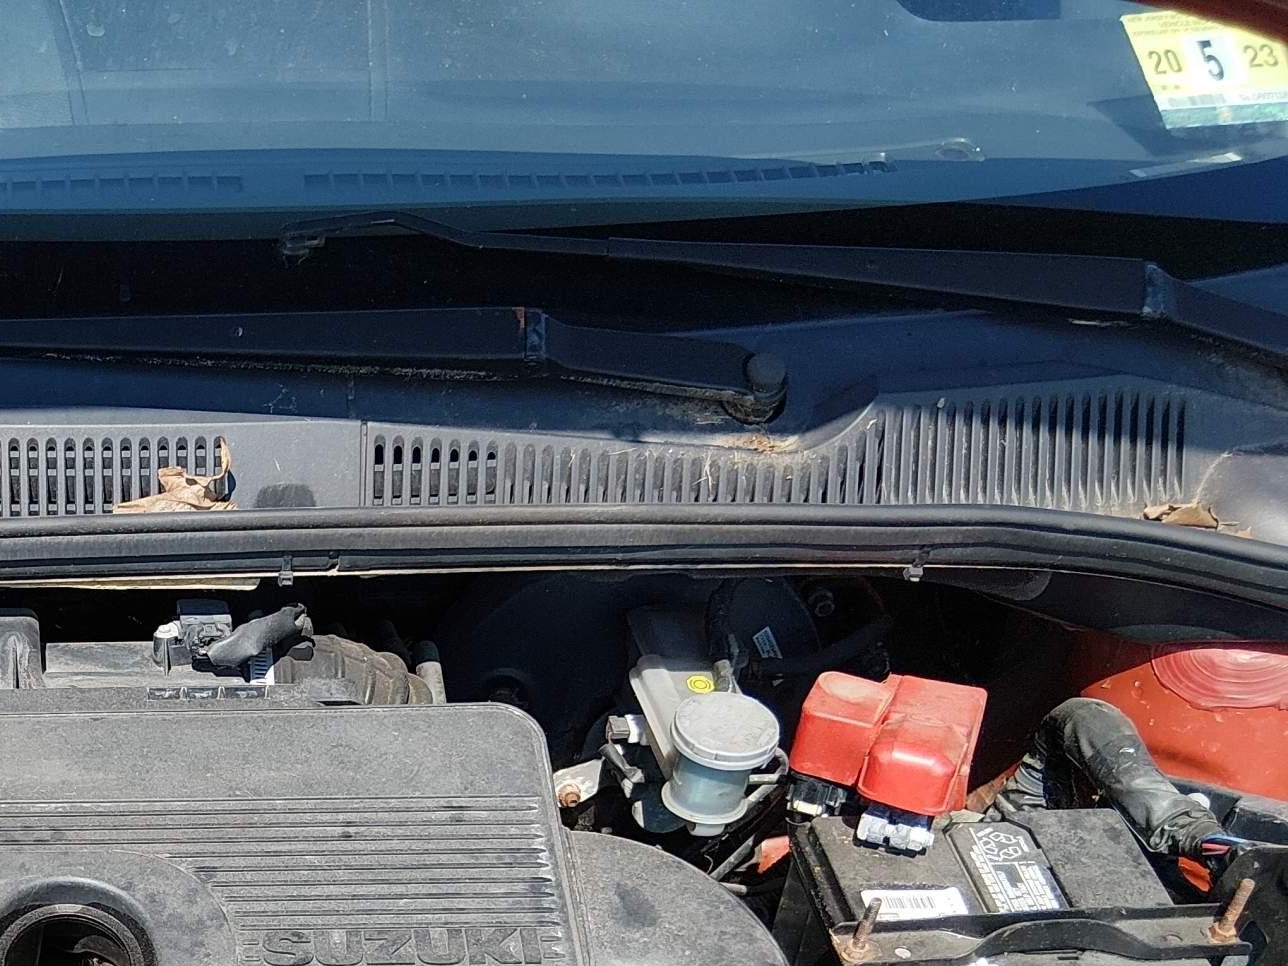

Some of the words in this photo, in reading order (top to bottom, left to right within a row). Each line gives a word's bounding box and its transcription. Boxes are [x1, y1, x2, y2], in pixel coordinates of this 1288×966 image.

[1148, 49, 1183, 75] 20
[1196, 39, 1225, 81] 5
[1243, 44, 1279, 69] 23
[262, 927, 542, 966] SUZUKI
